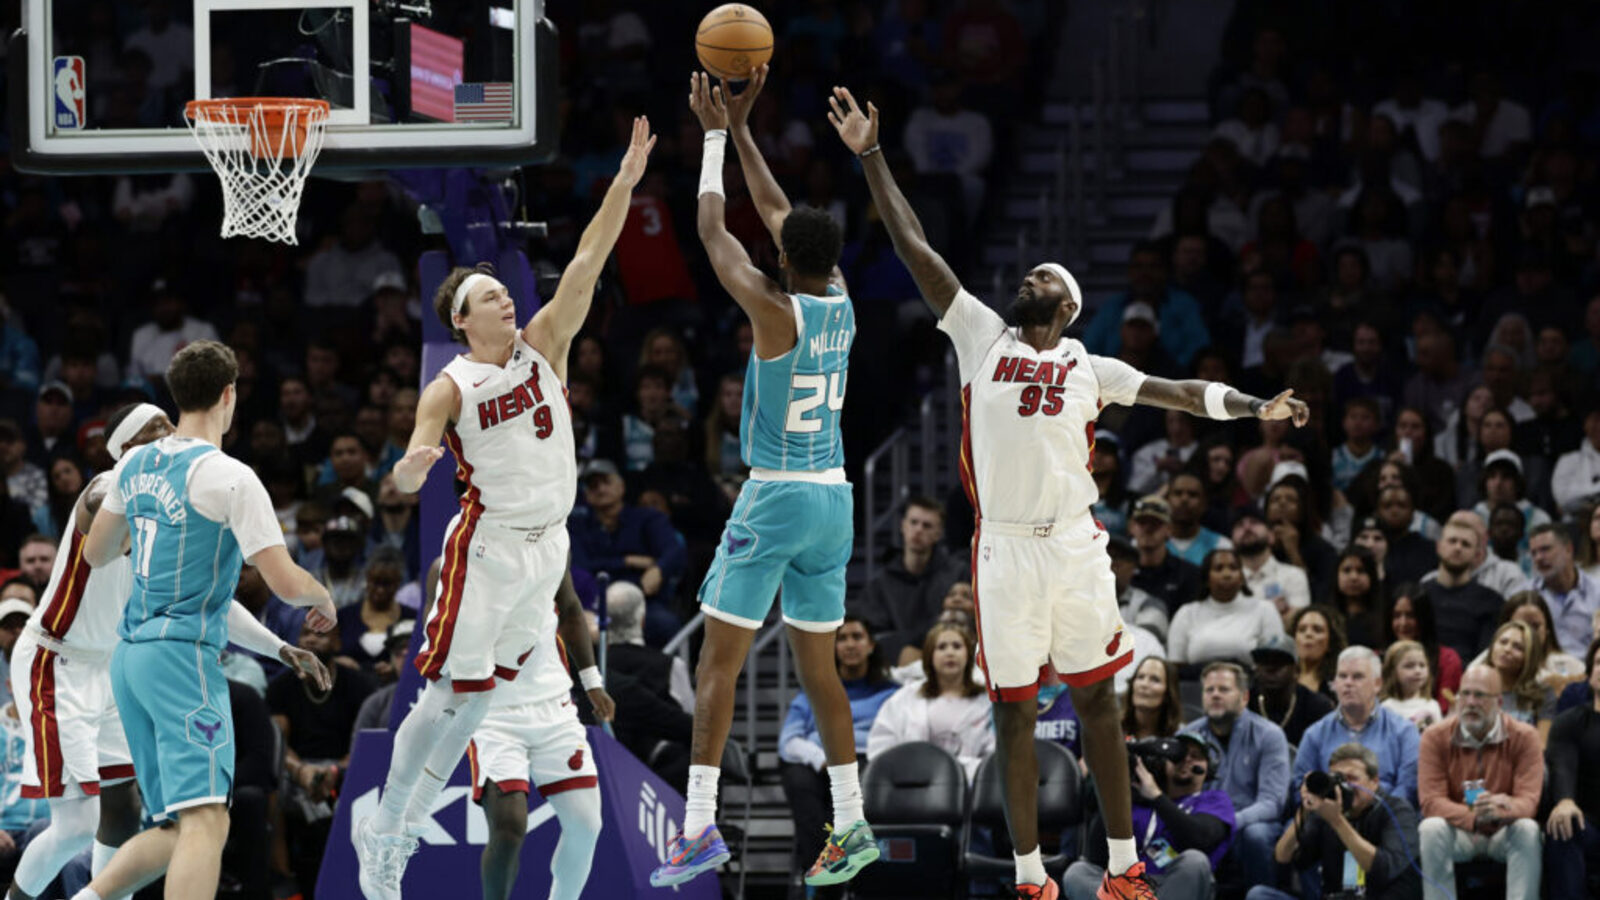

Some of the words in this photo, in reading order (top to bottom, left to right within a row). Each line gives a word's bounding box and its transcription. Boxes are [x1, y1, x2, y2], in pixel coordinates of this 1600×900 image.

[642, 206, 662, 237] 3
[810, 328, 850, 360] MILLER
[991, 356, 1077, 386] HEAT
[477, 361, 545, 431] HEAT
[784, 371, 848, 433] 24
[1017, 385, 1066, 417] 95
[532, 404, 554, 440] 9
[134, 516, 158, 577] 11
